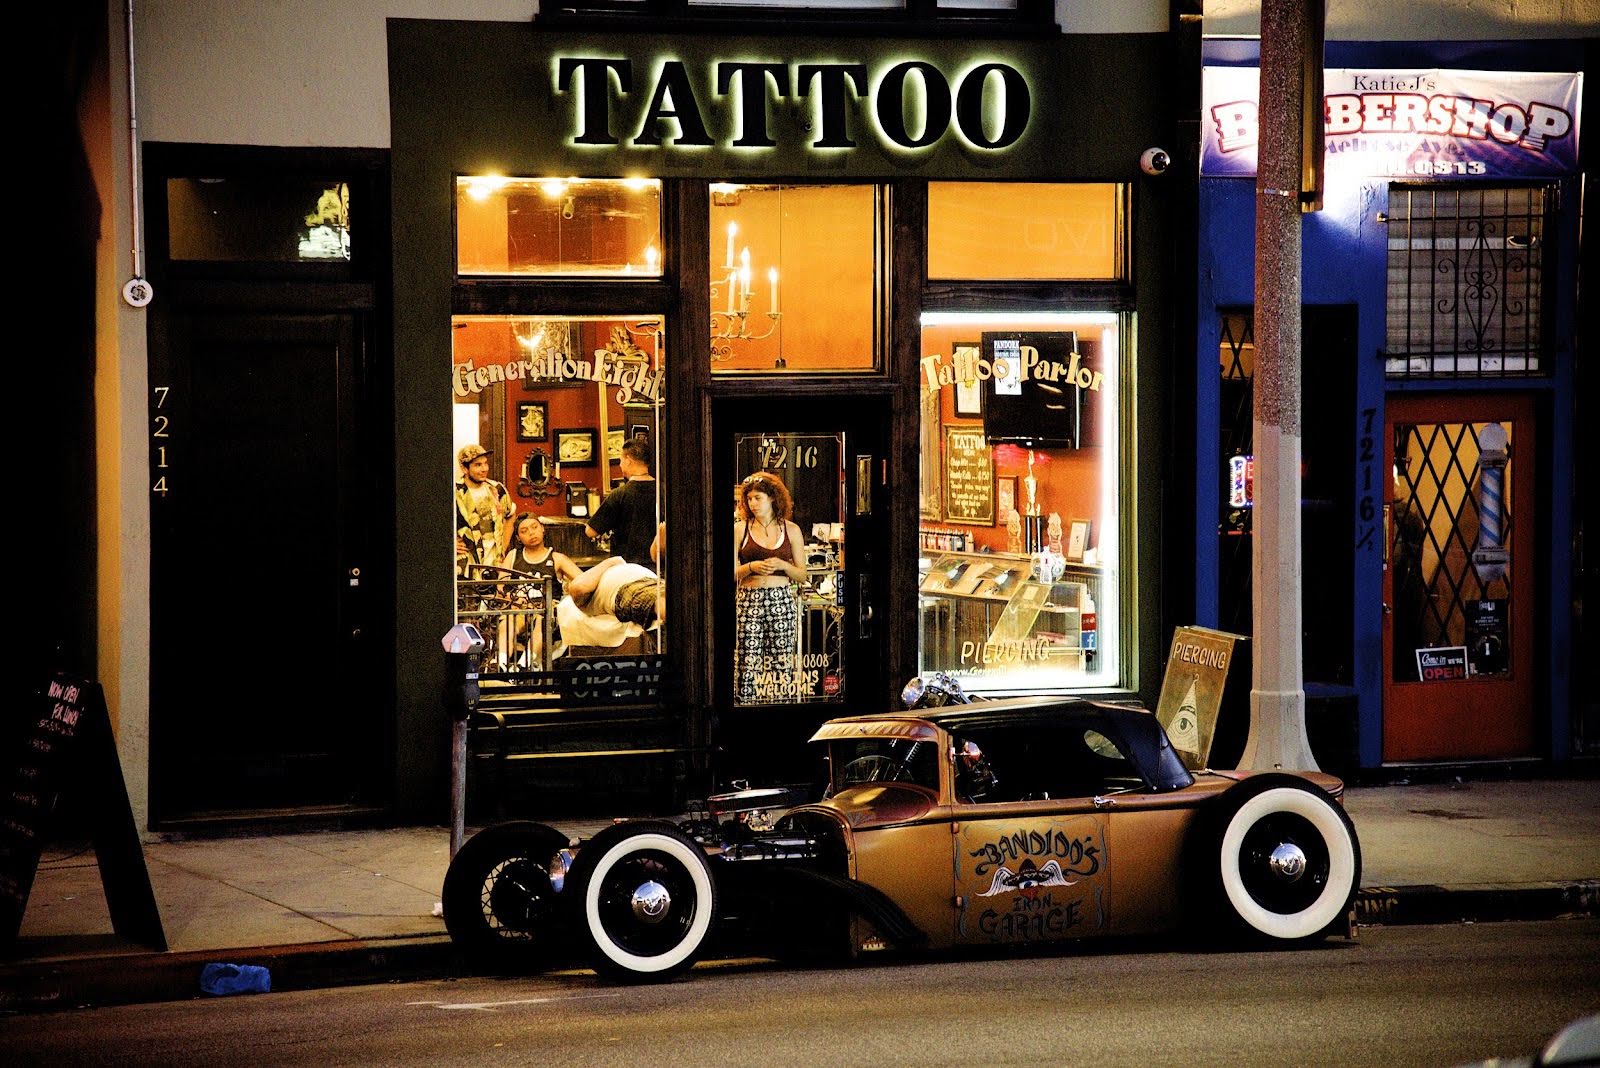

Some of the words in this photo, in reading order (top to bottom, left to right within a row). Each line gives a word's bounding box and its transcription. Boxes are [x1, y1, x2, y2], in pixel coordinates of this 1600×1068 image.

[1353, 75, 1405, 92] Katie
[1409, 75, 1436, 92] J's
[557, 57, 1032, 150] TATTOO
[1210, 91, 1572, 153] BBERSHOP
[452, 347, 592, 397] Generation
[921, 348, 1009, 393] Tattoo
[1018, 346, 1105, 392] Parlor
[153, 386, 169, 498] 7214
[757, 446, 818, 468] 7216
[961, 638, 1050, 664] PIERCING
[1173, 641, 1227, 670] PIERCING
[1424, 666, 1464, 679] OPEN
[754, 683, 816, 696] WELCOME
[1013, 894, 1052, 912] IRON
[979, 897, 1083, 939] GARAGE
